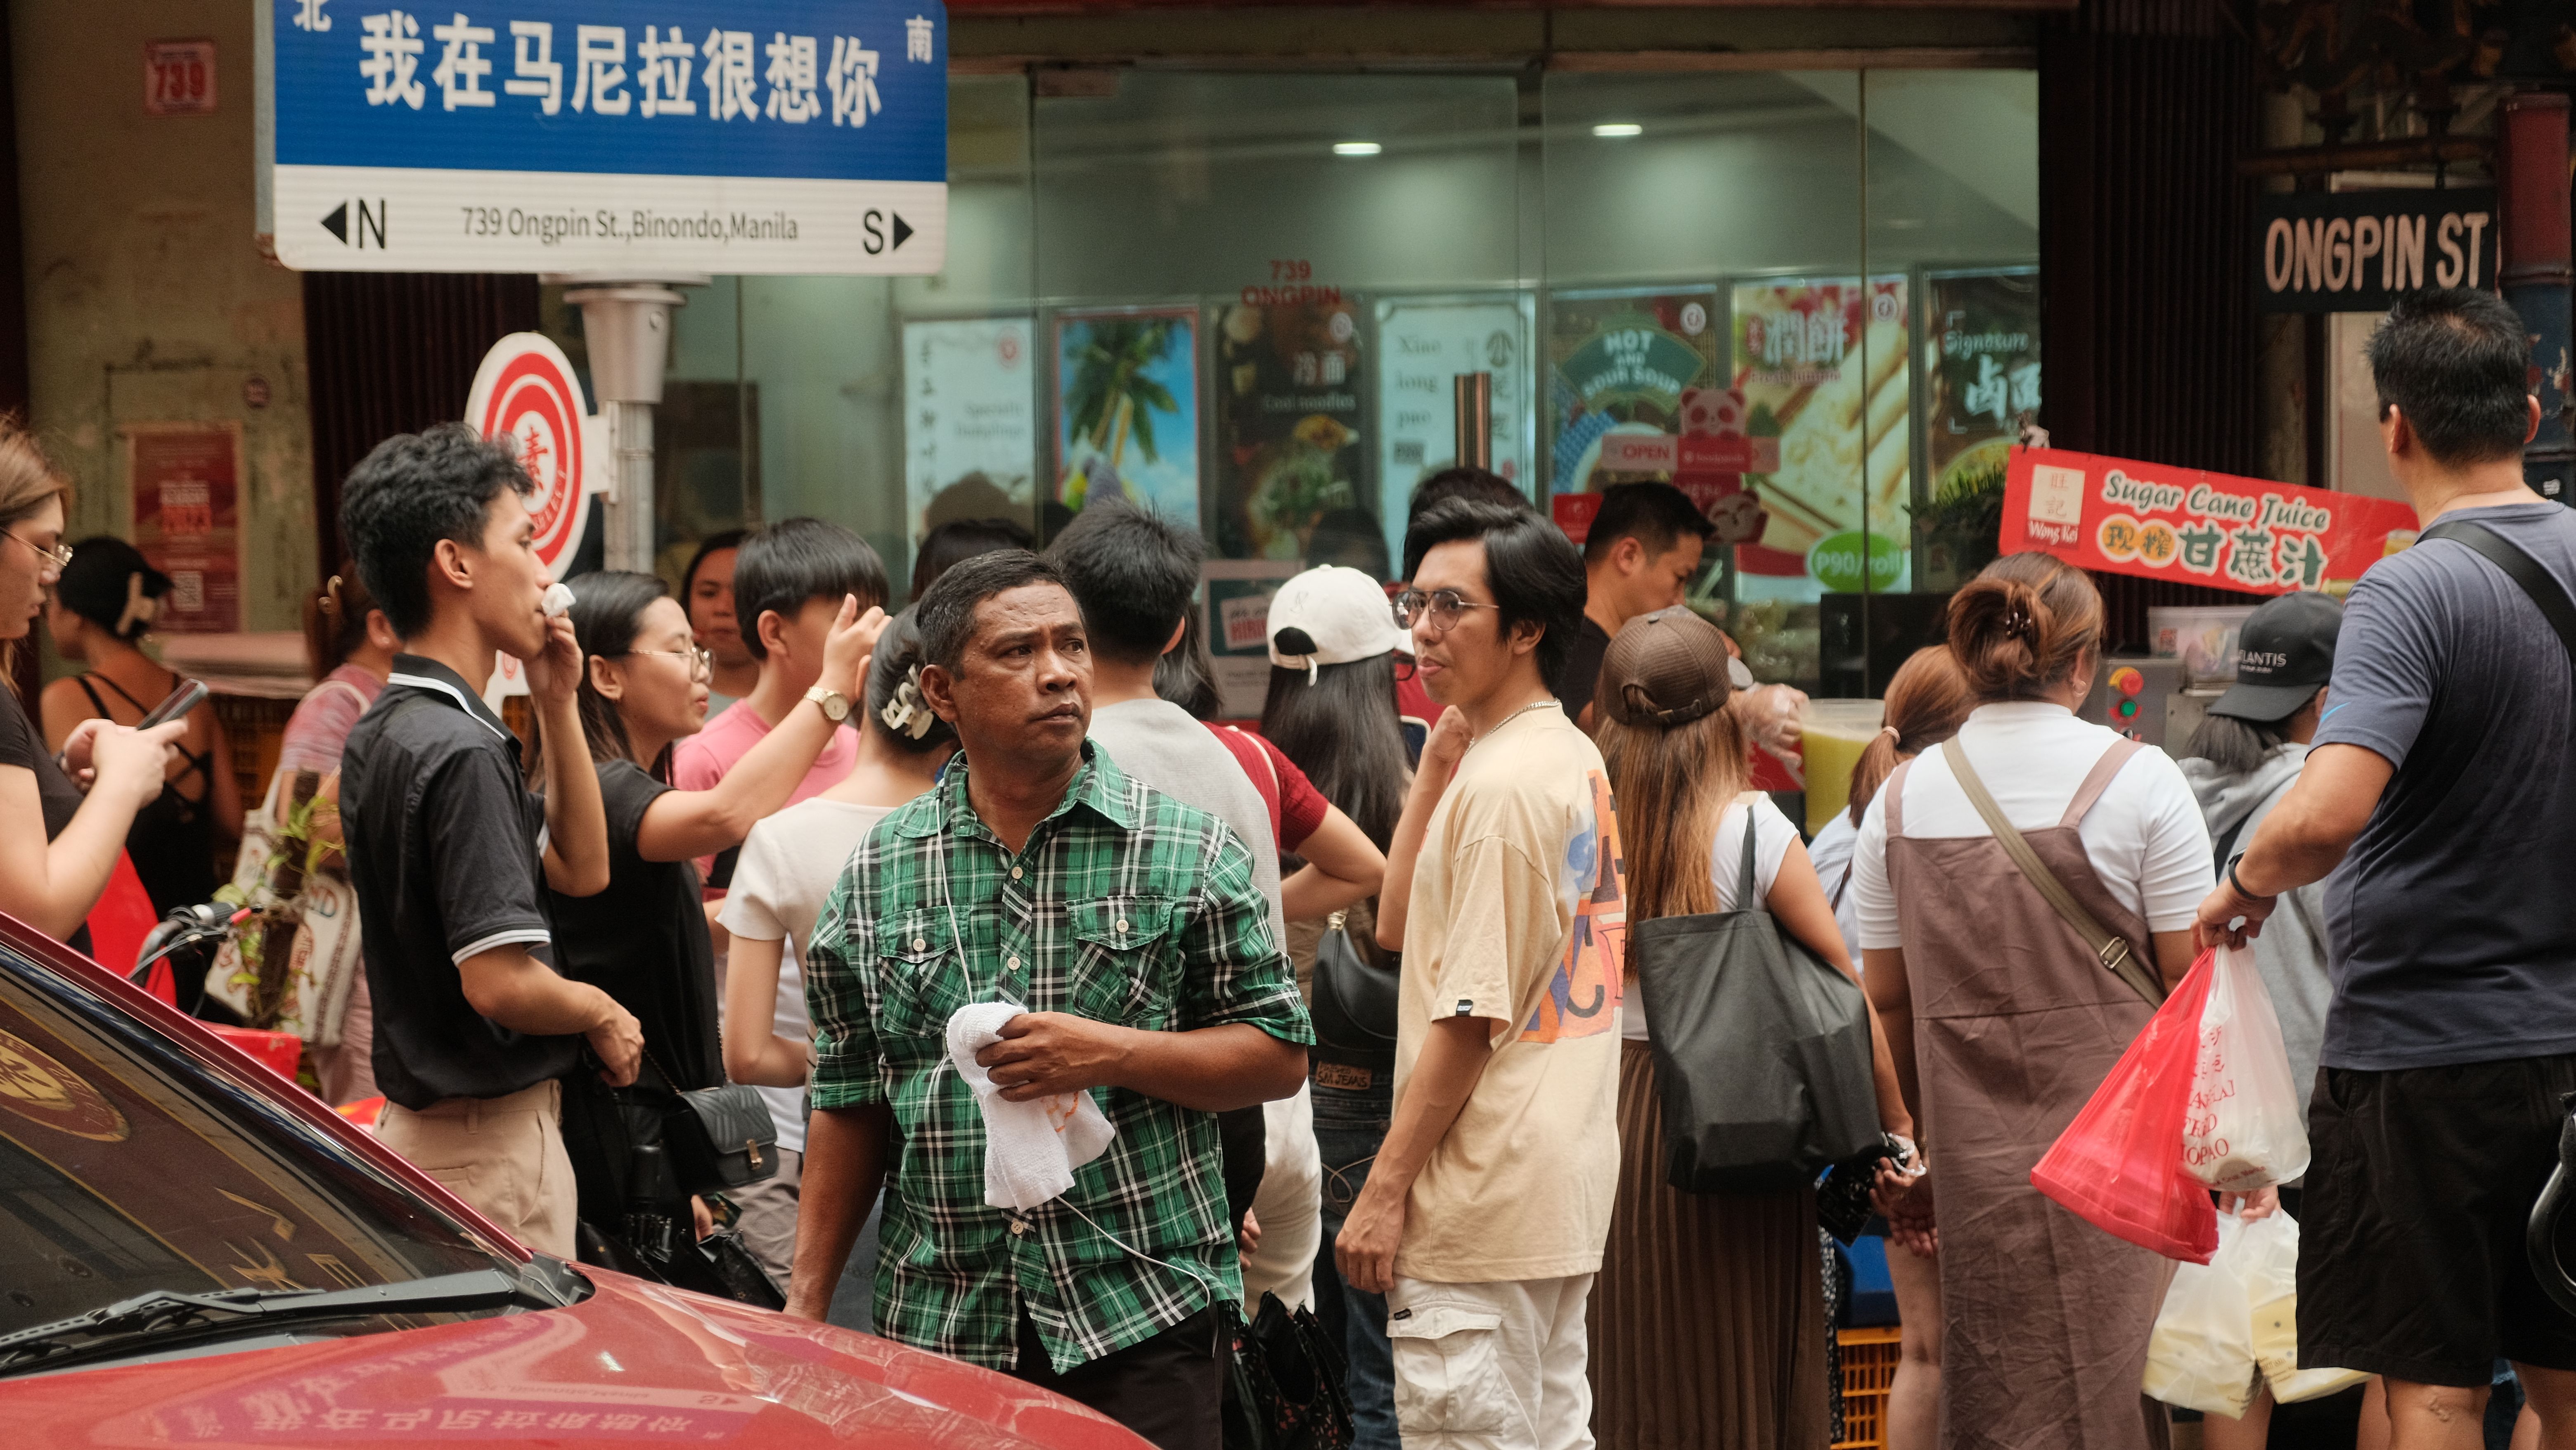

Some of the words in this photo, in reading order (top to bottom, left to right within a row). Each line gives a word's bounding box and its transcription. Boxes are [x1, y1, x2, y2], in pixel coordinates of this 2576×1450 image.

[904, 15, 934, 64] 南
[359, 10, 881, 129] 我在马尼拉很想你
[356, 197, 387, 251] N
[462, 207, 502, 236] 739
[507, 207, 591, 245] Ongpin
[862, 208, 885, 255] S
[1269, 259, 1312, 281] 739
[2264, 213, 2427, 293] ONGPIN
[2436, 211, 2490, 291] ST
[1241, 284, 1342, 308] ONGPIN
[1604, 329, 1655, 356] HOT
[1622, 443, 1671, 459] OPEN
[2105, 473, 2182, 510] Sugar
[2189, 486, 2254, 518] Cane
[2260, 498, 2329, 530] Juice
[2027, 519, 2060, 545] Wong
